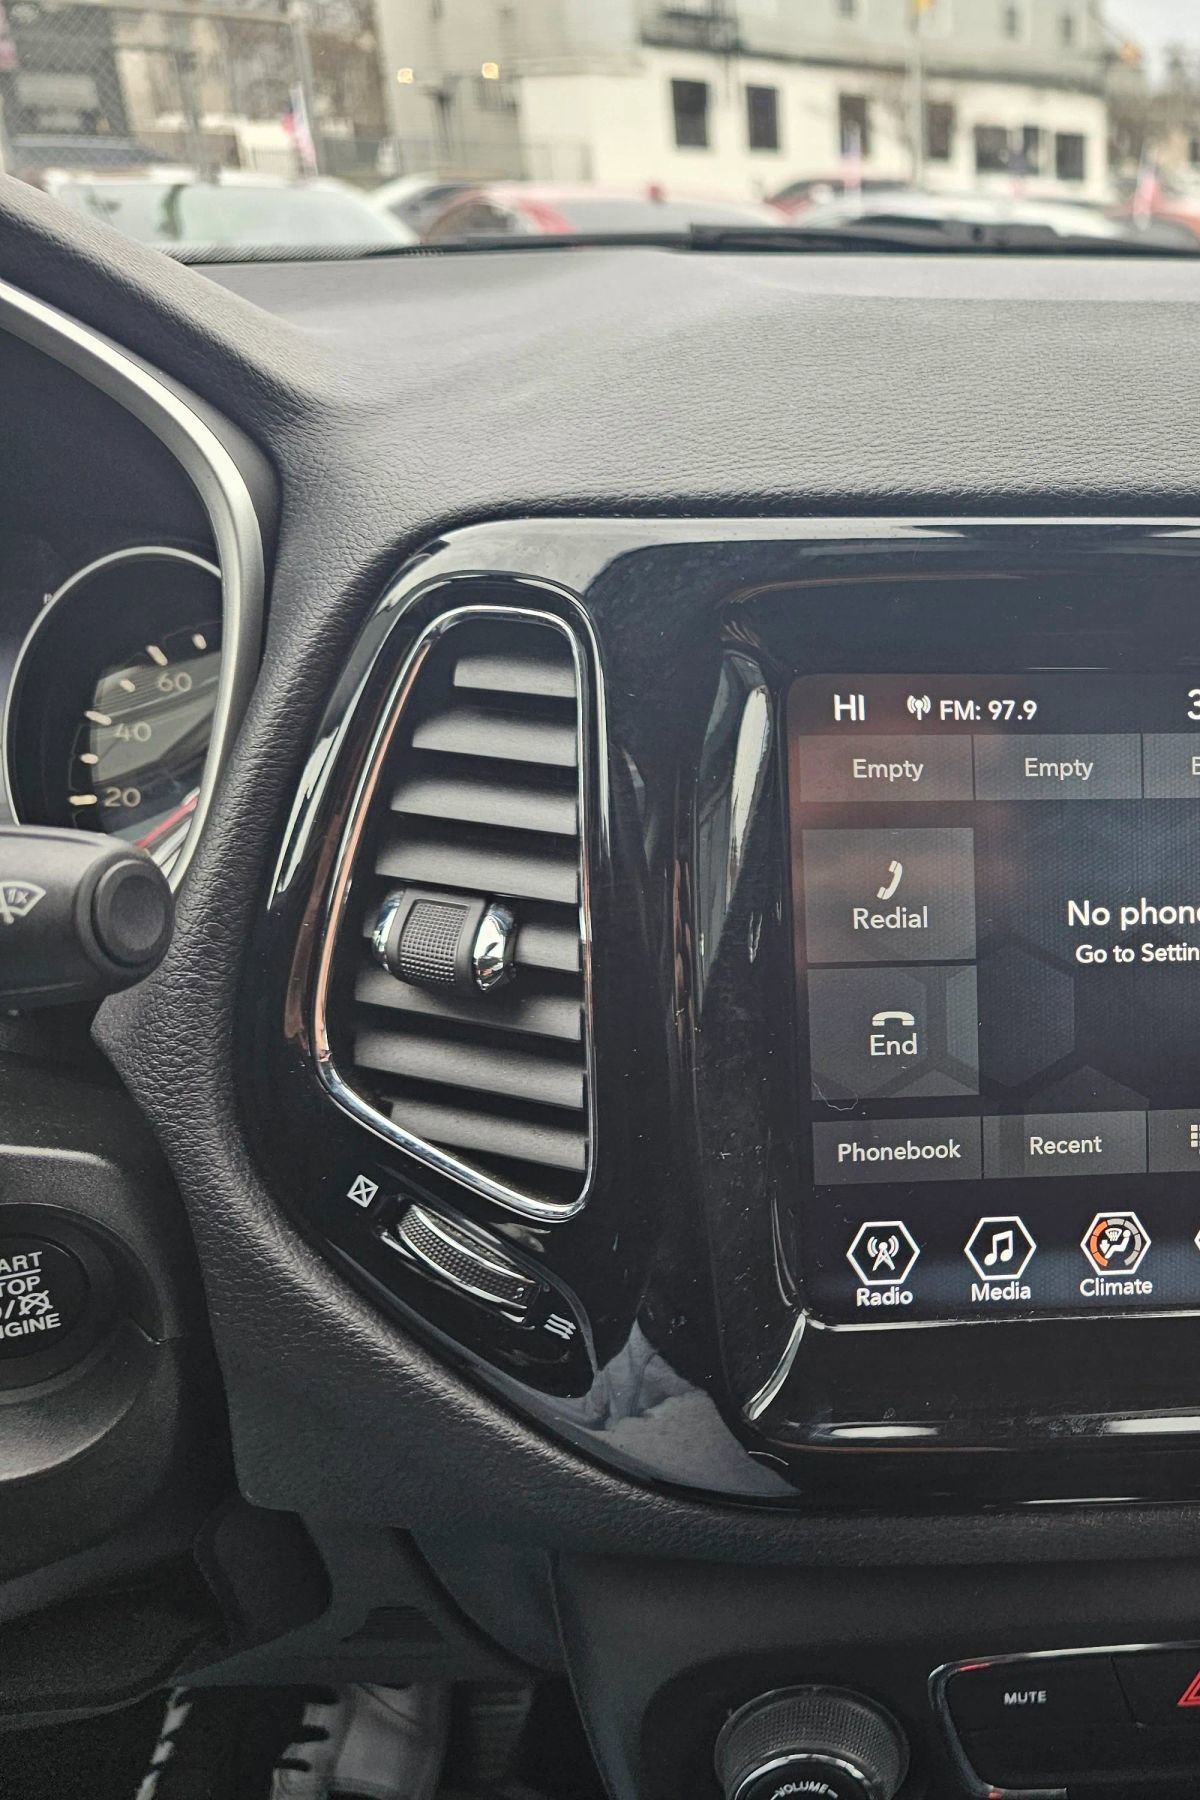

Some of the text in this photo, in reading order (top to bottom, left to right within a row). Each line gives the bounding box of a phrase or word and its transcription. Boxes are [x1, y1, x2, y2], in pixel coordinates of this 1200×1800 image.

[156, 671, 193, 693] 60
[833, 694, 866, 721] HI
[939, 699, 1038, 721] FM: 97.9
[114, 721, 152, 742] 40
[853, 758, 924, 783] Empty
[1024, 757, 1094, 781] Empty
[103, 786, 142, 807] 20
[853, 905, 928, 930] Redial
[1067, 899, 1111, 927] No
[1075, 944, 1108, 964] Go
[1112, 945, 1136, 963] to
[870, 1032, 918, 1056] End
[838, 1138, 962, 1163] Phonebook
[1030, 1135, 1103, 1155] Recent
[0, 1251, 42, 1272] ART
[0, 1276, 41, 1297] TOP
[856, 1285, 914, 1307] Radio
[971, 1280, 1032, 1302] Media
[1079, 1277, 1153, 1297] Climate
[0, 1312, 61, 1338] GINE
[1004, 1690, 1047, 1705] MUTE
[775, 1780, 829, 1798] VOLUME
